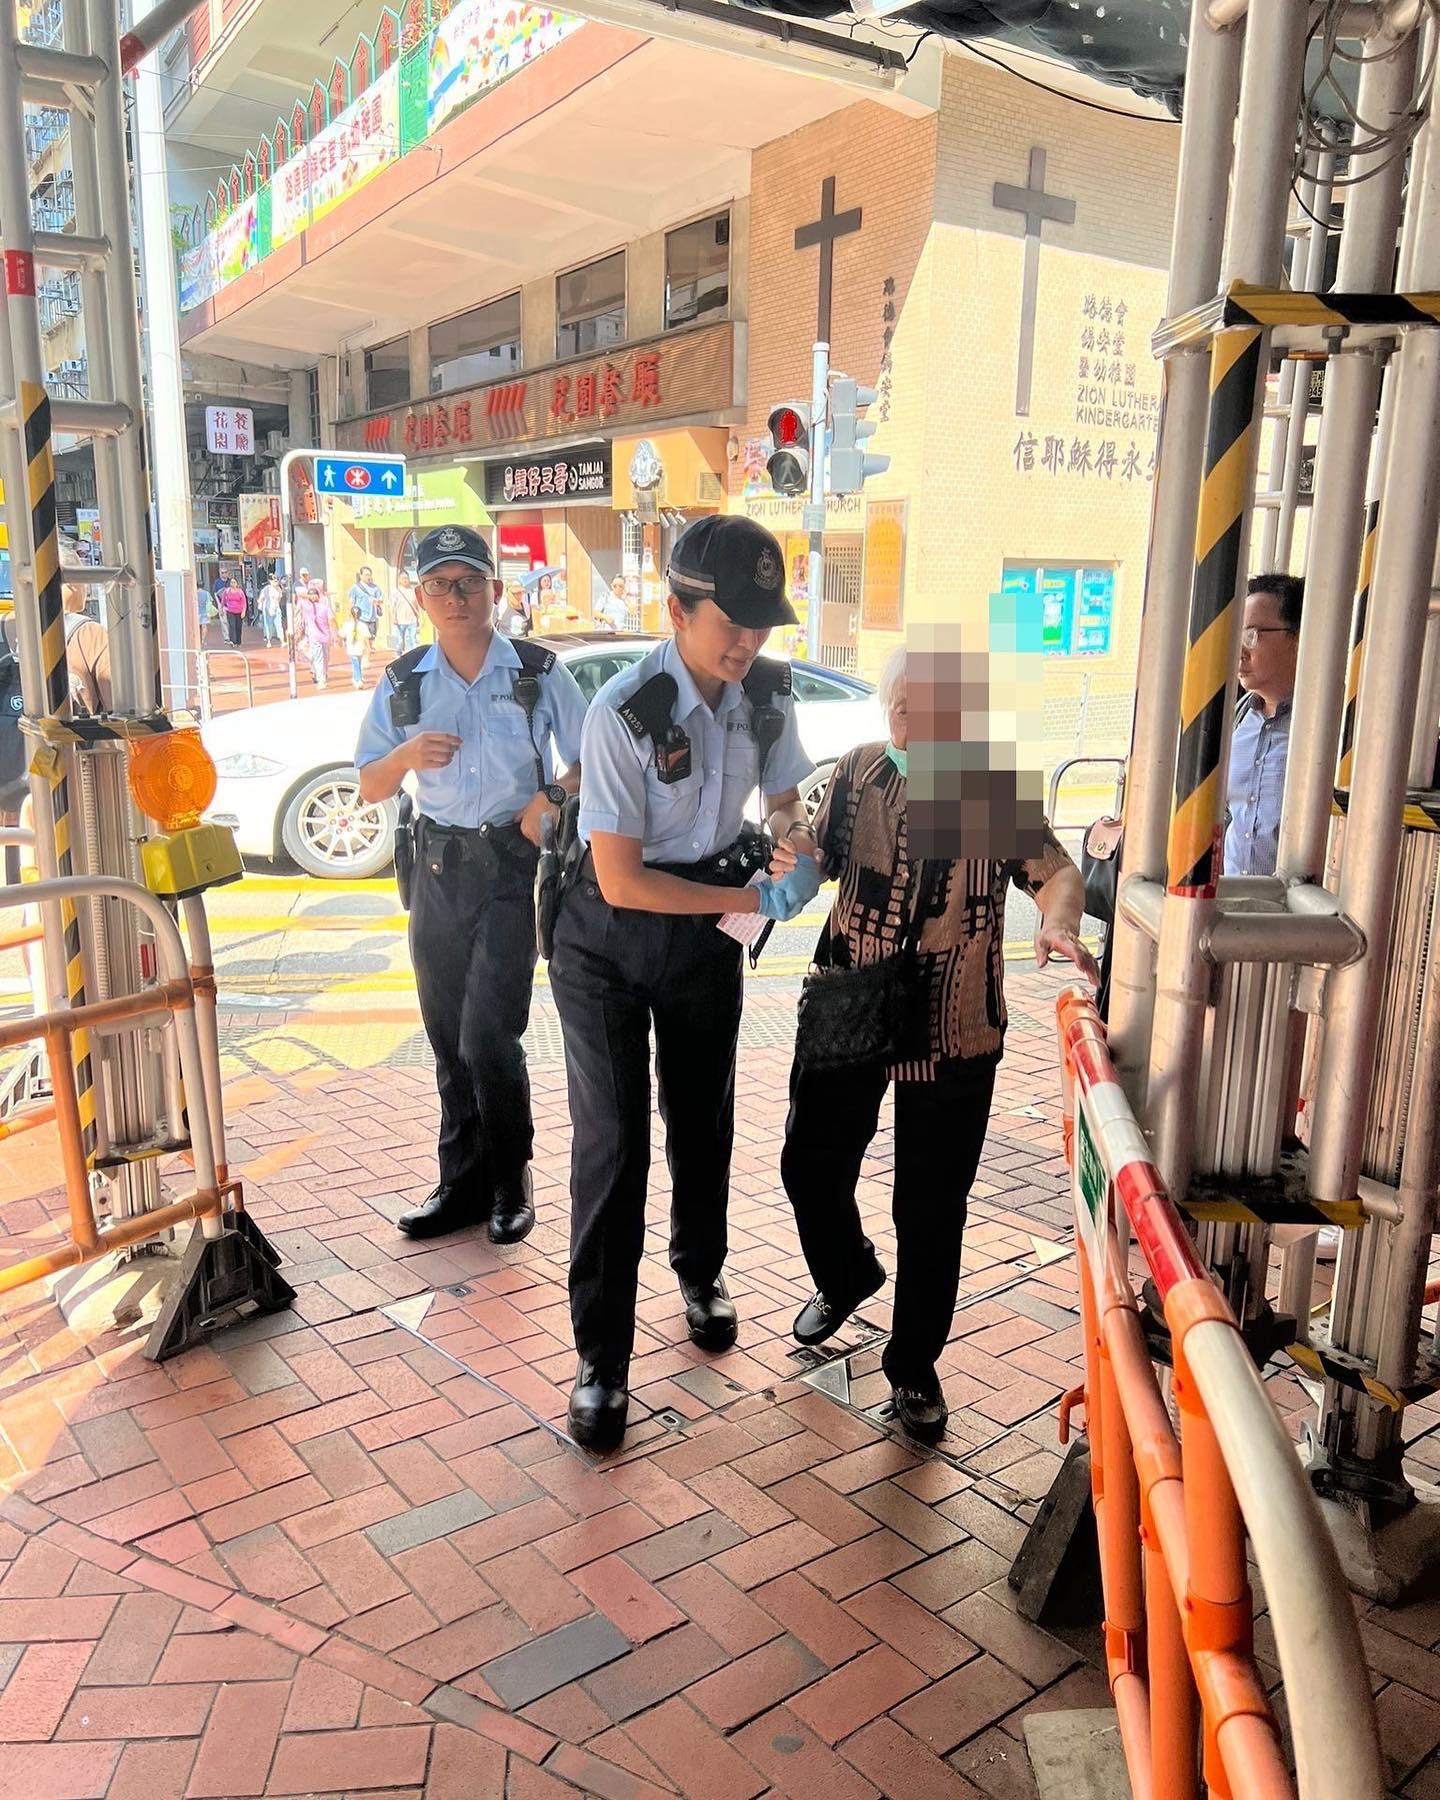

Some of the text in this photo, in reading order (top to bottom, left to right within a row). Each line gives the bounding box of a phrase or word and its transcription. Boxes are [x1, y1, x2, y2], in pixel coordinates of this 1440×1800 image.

[1082, 293, 1128, 327] 路德會
[1080, 325, 1126, 357] 錫安堂
[1077, 384, 1106, 405] ZION
[578, 460, 604, 475] TAMJAI
[578, 475, 604, 491] SAMGOR
[746, 502, 766, 517] ZION
[826, 497, 861, 514] HURCH
